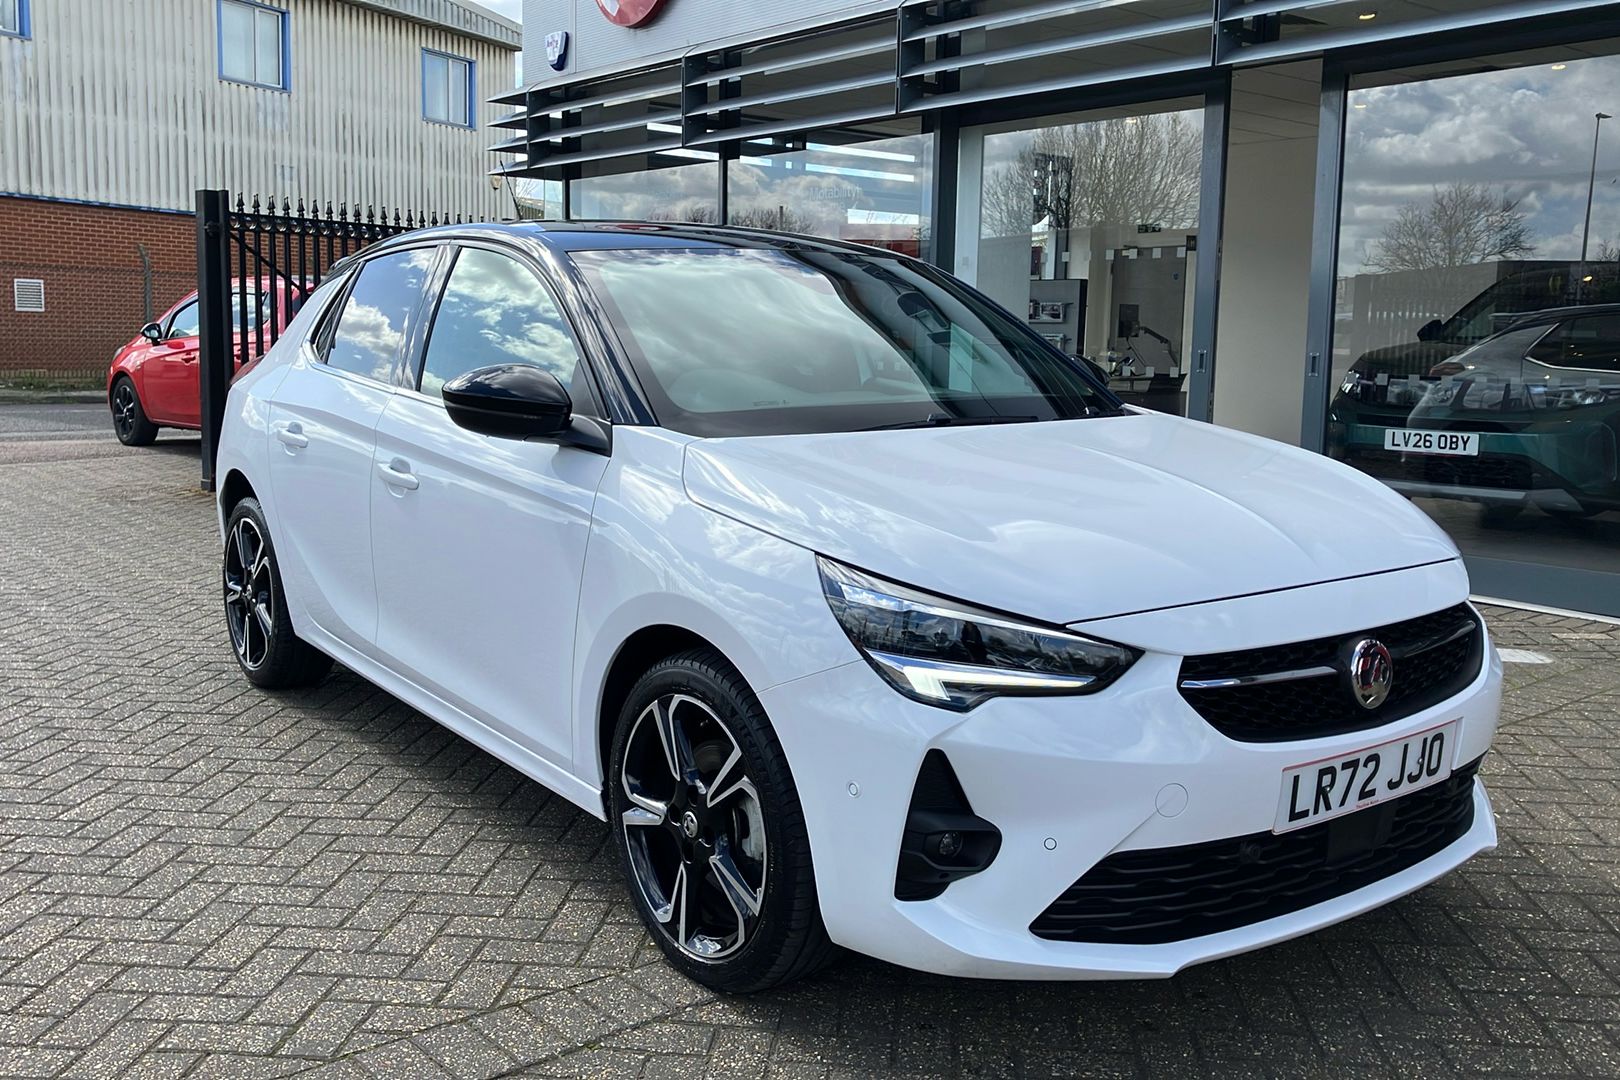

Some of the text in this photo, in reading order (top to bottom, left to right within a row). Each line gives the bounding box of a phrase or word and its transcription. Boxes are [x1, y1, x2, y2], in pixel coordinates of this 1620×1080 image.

[809, 184, 857, 201] Motability
[1391, 431, 1471, 451] LV26 OBY
[1288, 732, 1444, 822] LR72 JJO
